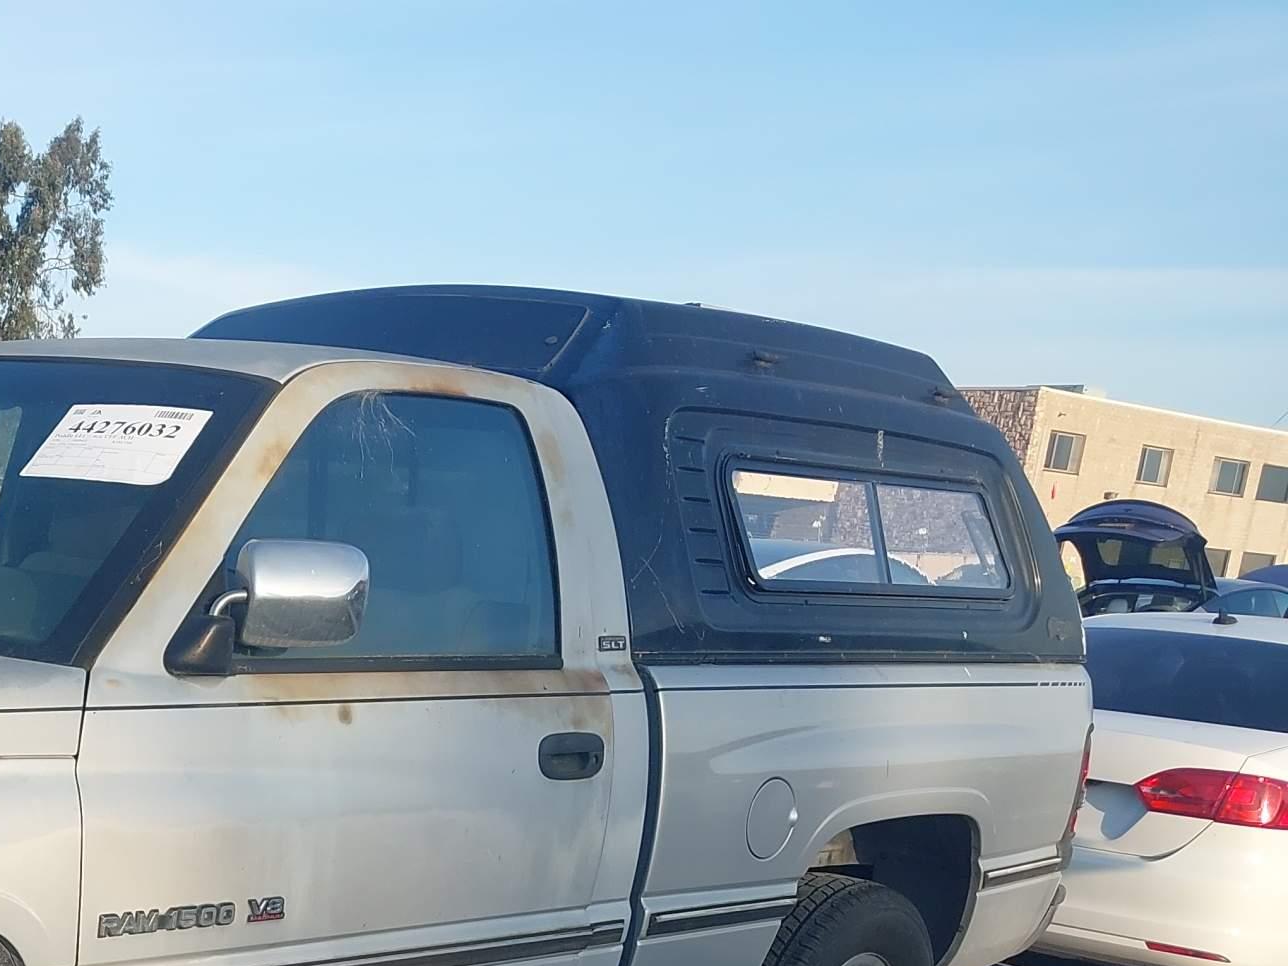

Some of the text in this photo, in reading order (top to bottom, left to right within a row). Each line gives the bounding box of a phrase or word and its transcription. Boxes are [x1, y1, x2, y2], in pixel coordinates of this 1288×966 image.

[68, 420, 182, 439] 44276032
[602, 640, 625, 649] SLT
[247, 896, 285, 915] V8
[97, 902, 236, 938] RAM 1500
